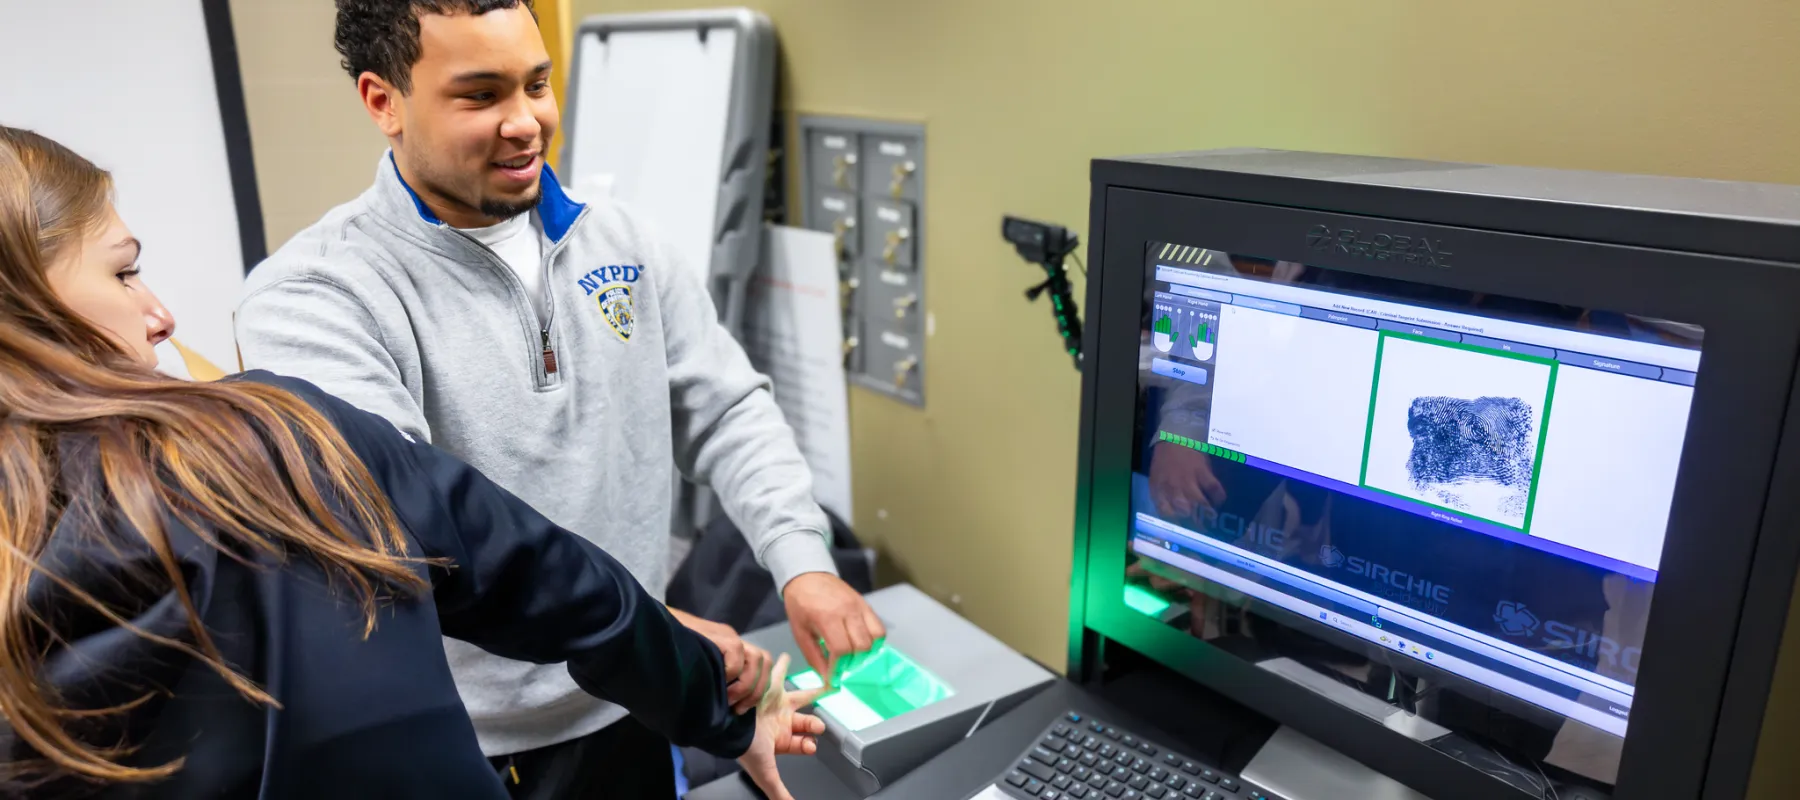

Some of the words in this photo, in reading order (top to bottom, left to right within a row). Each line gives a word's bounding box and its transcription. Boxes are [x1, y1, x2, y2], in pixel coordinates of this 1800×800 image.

[1338, 228, 1453, 256] GLOBAL
[578, 265, 640, 296] NYPD
[1172, 367, 1186, 376] Stop
[1593, 359, 1621, 370] Signature
[1347, 555, 1450, 605] SIRCHIE
